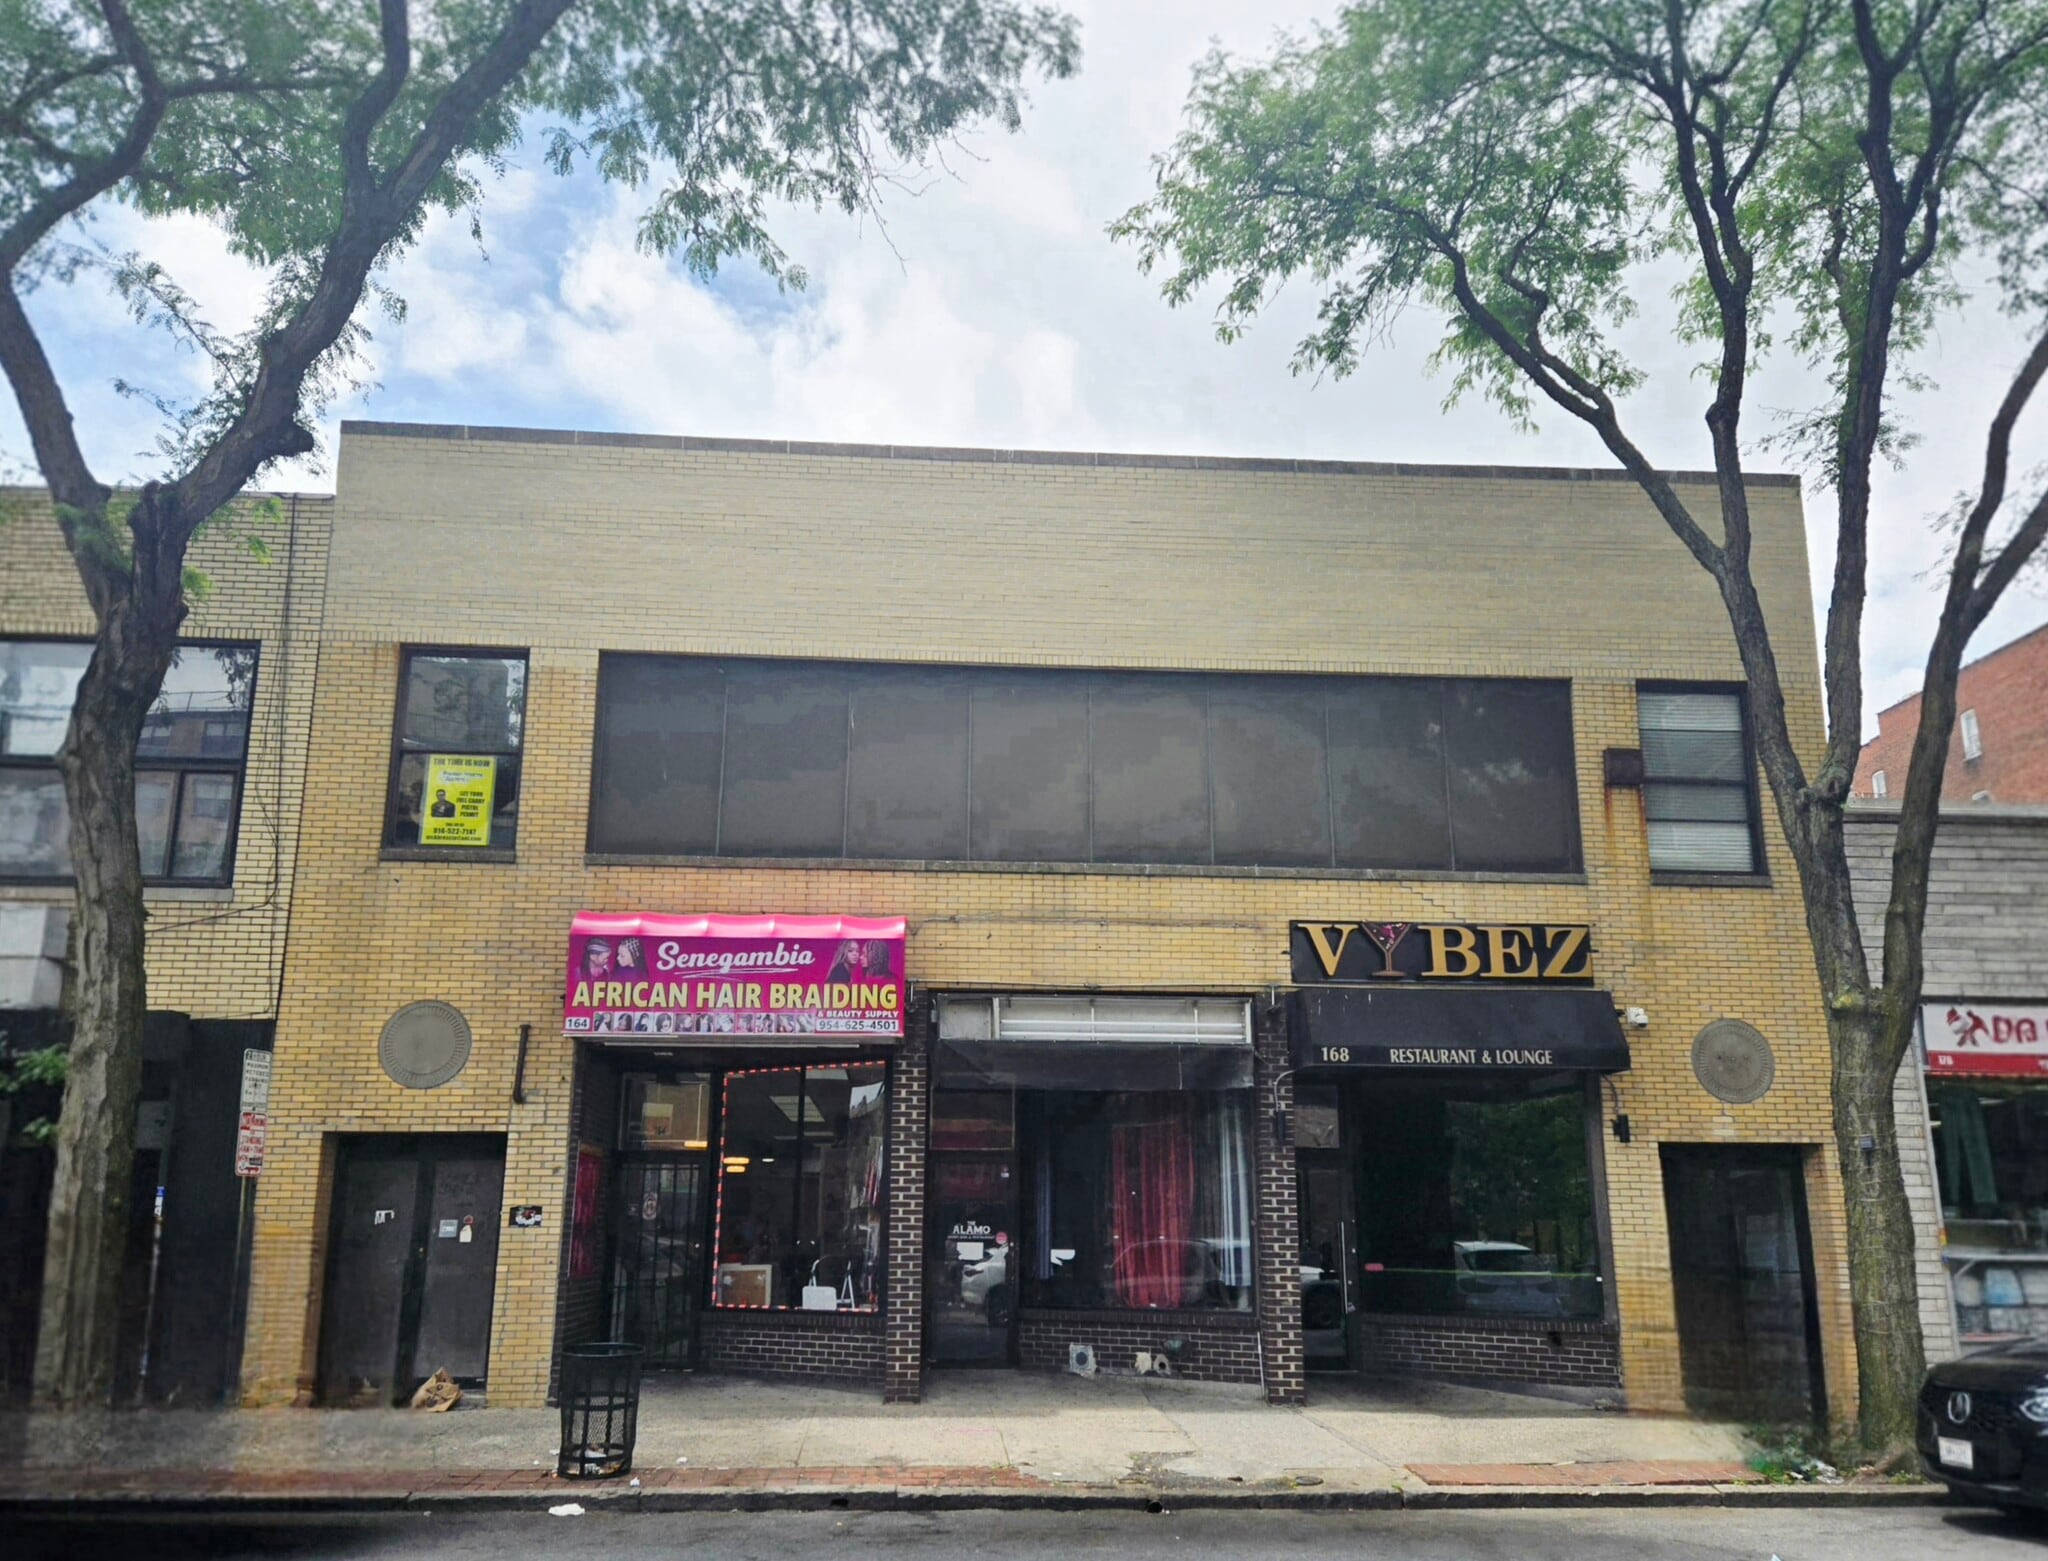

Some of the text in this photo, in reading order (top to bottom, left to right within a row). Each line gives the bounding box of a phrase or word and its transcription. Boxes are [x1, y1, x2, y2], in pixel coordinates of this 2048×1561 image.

[656, 941, 815, 973] Senegambia
[1297, 921, 1593, 978] VYBEZ
[571, 981, 897, 1010] AFRICAN HAIR BRAIDING
[817, 1010, 899, 1018] & BEAUTY SUPPLY
[567, 1018, 588, 1029] 164
[819, 1020, 897, 1031] 954-625-4501
[1321, 1047, 1350, 1062] 168
[1390, 1049, 1553, 1065] RESTAURANT & LOUNGE
[953, 1225, 991, 1234] ALAMO
